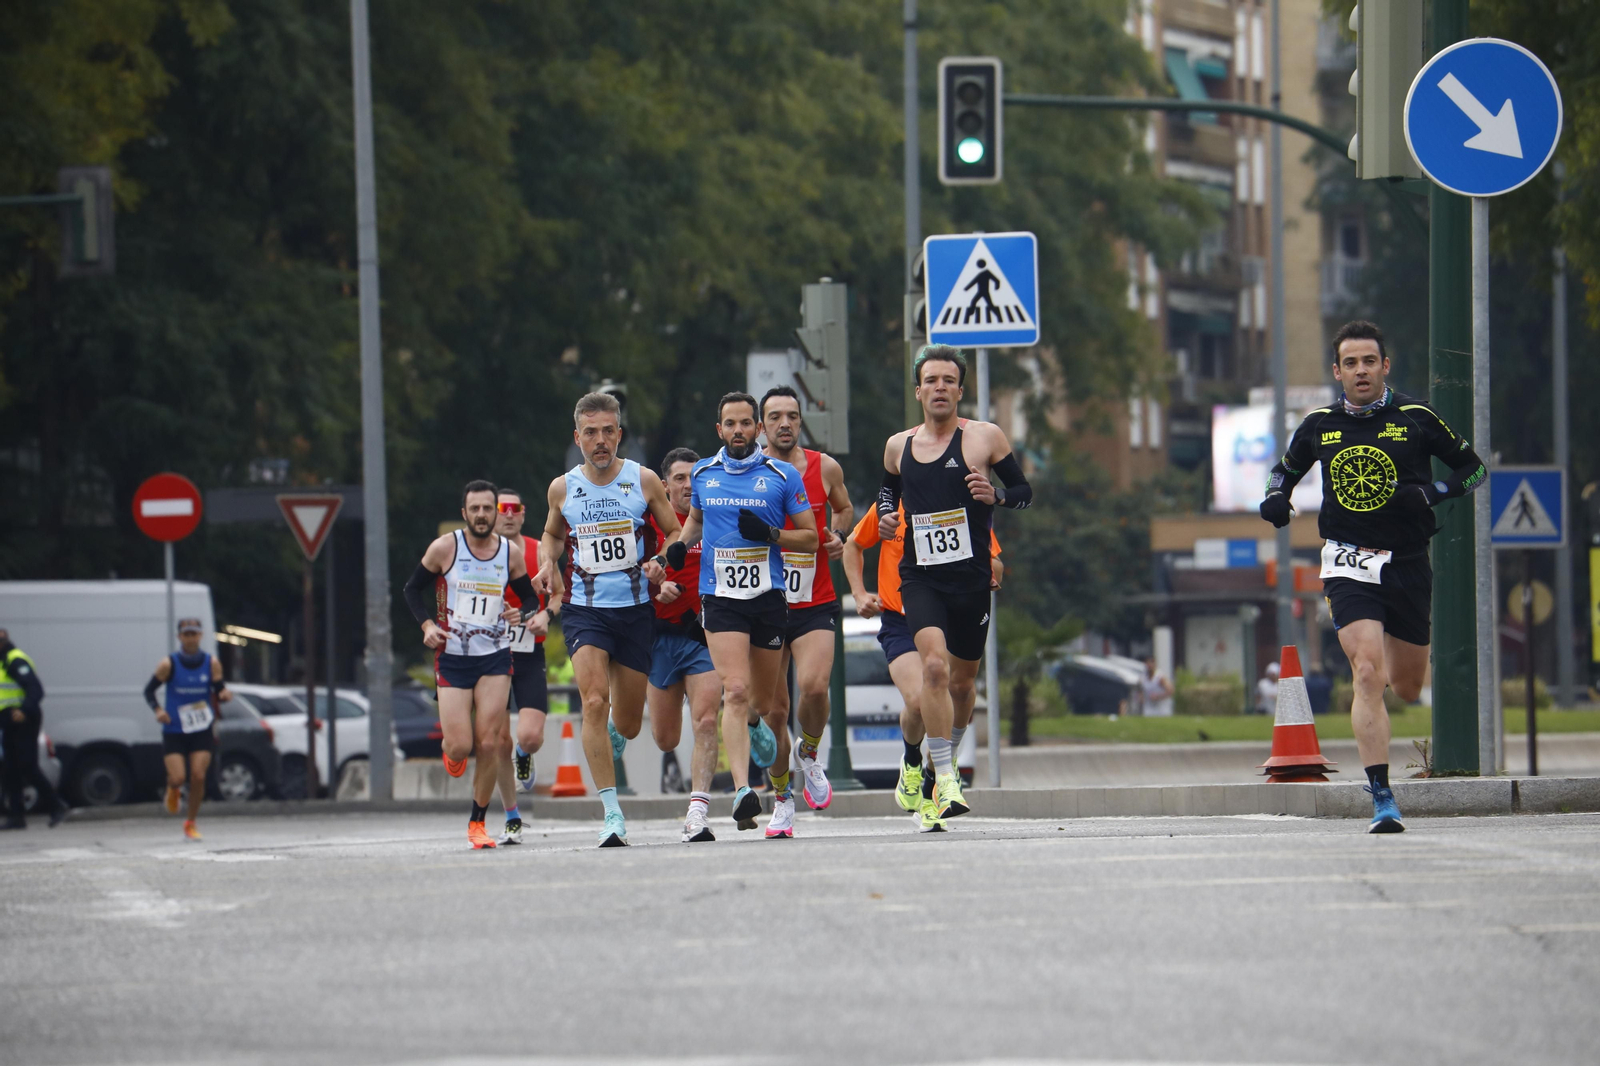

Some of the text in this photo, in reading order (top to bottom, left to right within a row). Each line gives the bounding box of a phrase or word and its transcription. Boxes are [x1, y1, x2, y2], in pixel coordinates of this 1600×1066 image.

[1321, 430, 1342, 441] uve
[1377, 431, 1402, 439] phone
[581, 497, 621, 511] Triatlon
[705, 497, 767, 507] TROTASIERRA
[914, 516, 932, 525] XXXIX
[577, 524, 599, 534] XXXIX
[924, 528, 960, 554] 133
[591, 537, 626, 562] 198
[716, 550, 736, 559] XXXIX
[725, 565, 760, 588] 328
[471, 596, 488, 616] 11
